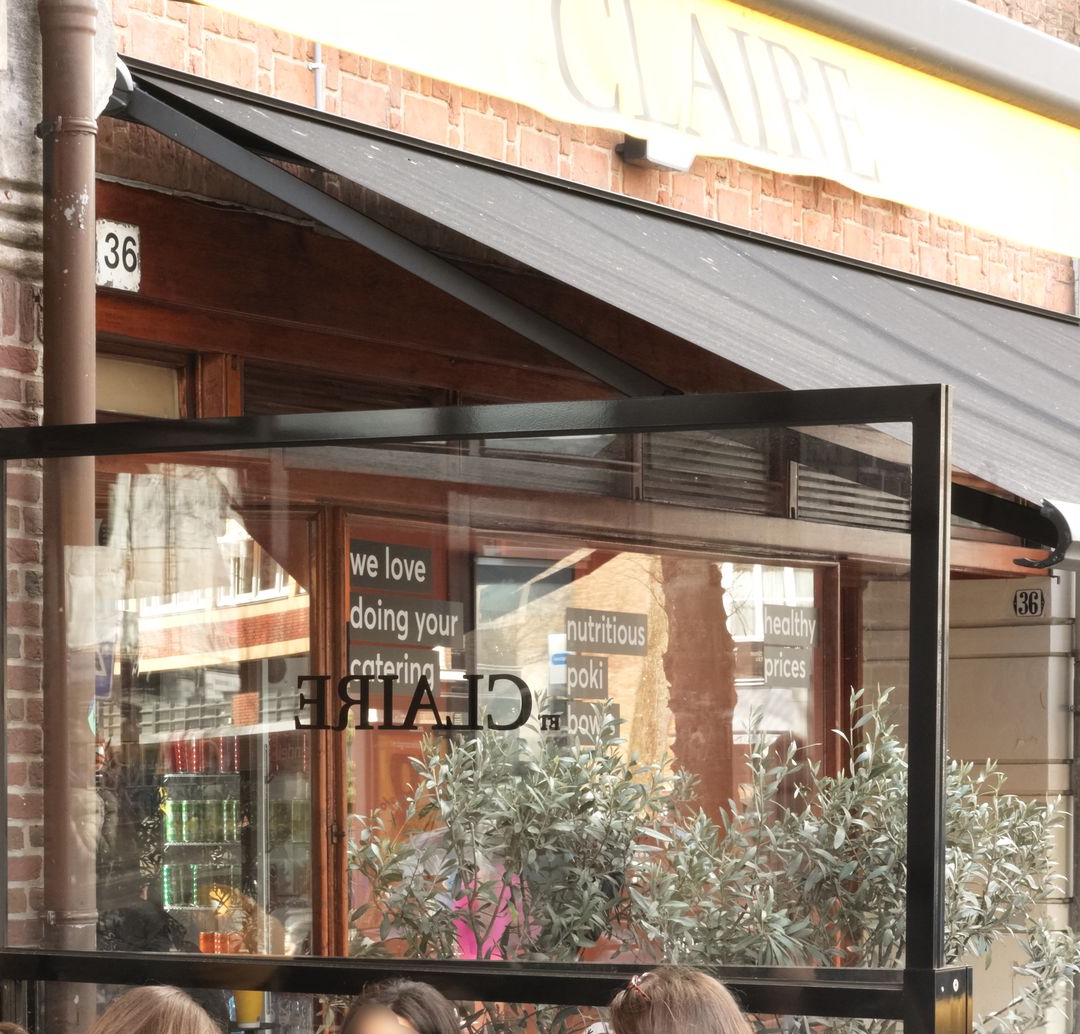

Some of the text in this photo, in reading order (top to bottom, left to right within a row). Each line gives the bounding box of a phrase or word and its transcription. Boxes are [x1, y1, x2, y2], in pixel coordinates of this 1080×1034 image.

[552, 0, 880, 183] CLAIRE
[104, 232, 137, 273] 36
[350, 546, 426, 583] we love
[350, 596, 458, 642] doing your
[1018, 591, 1038, 615] 36
[567, 615, 646, 647] nutritious
[764, 606, 816, 644] healthy
[350, 653, 435, 692] catering
[567, 659, 603, 695] poki
[764, 651, 807, 683] prices
